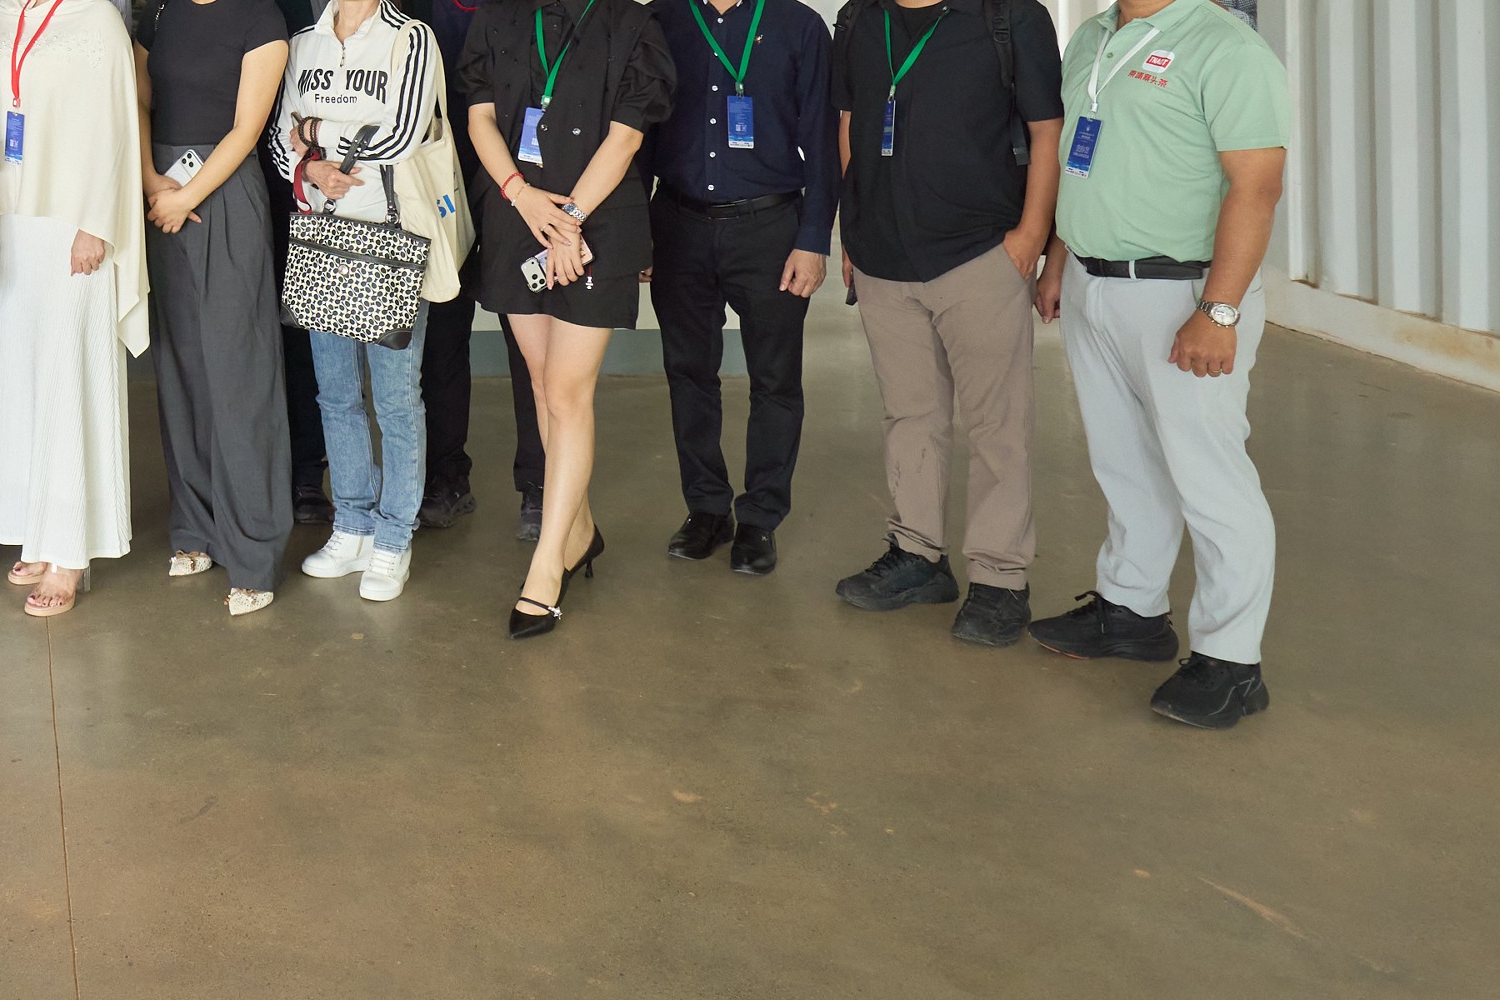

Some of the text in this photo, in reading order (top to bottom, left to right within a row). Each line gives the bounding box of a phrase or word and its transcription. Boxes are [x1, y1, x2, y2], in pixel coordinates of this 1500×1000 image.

[298, 68, 388, 104] MISS YOUR
[314, 93, 357, 104] Freedom
